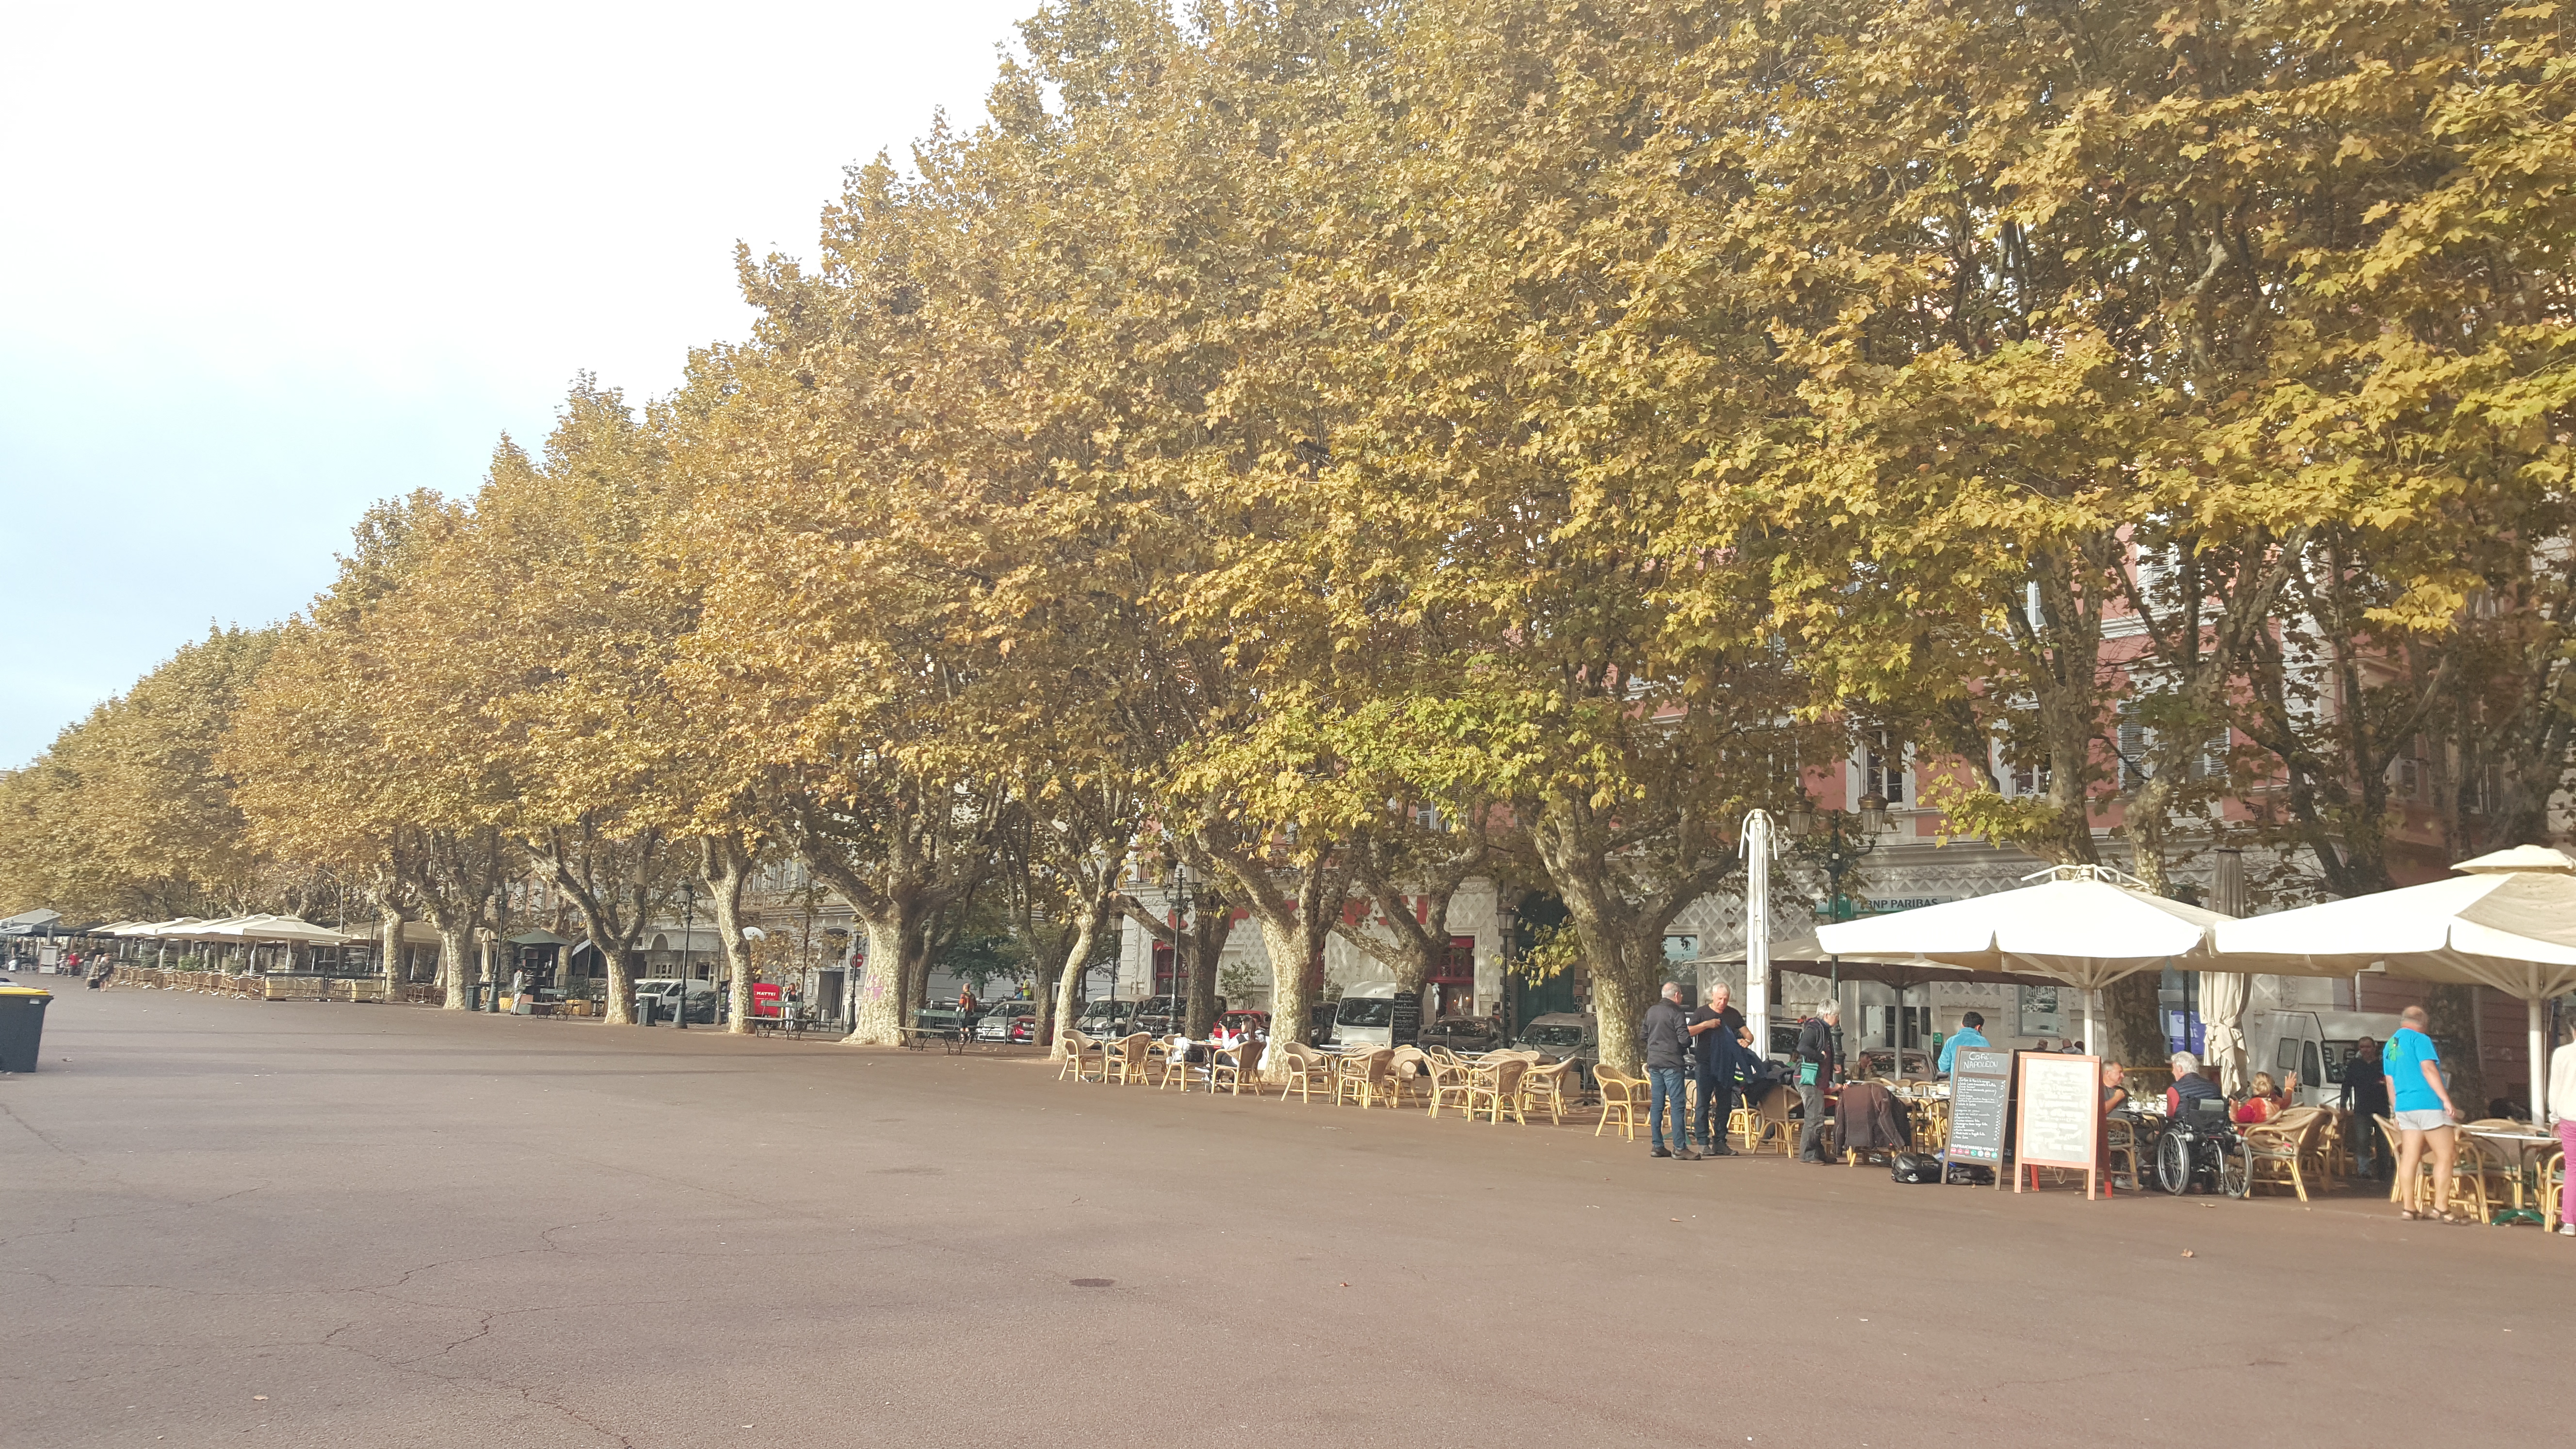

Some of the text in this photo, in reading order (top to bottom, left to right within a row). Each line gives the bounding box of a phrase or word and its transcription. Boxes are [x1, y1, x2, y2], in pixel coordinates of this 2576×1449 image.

[1868, 898, 1938, 908] BNP PARIBAS
[1963, 1061, 1998, 1069] NAPOLEON
